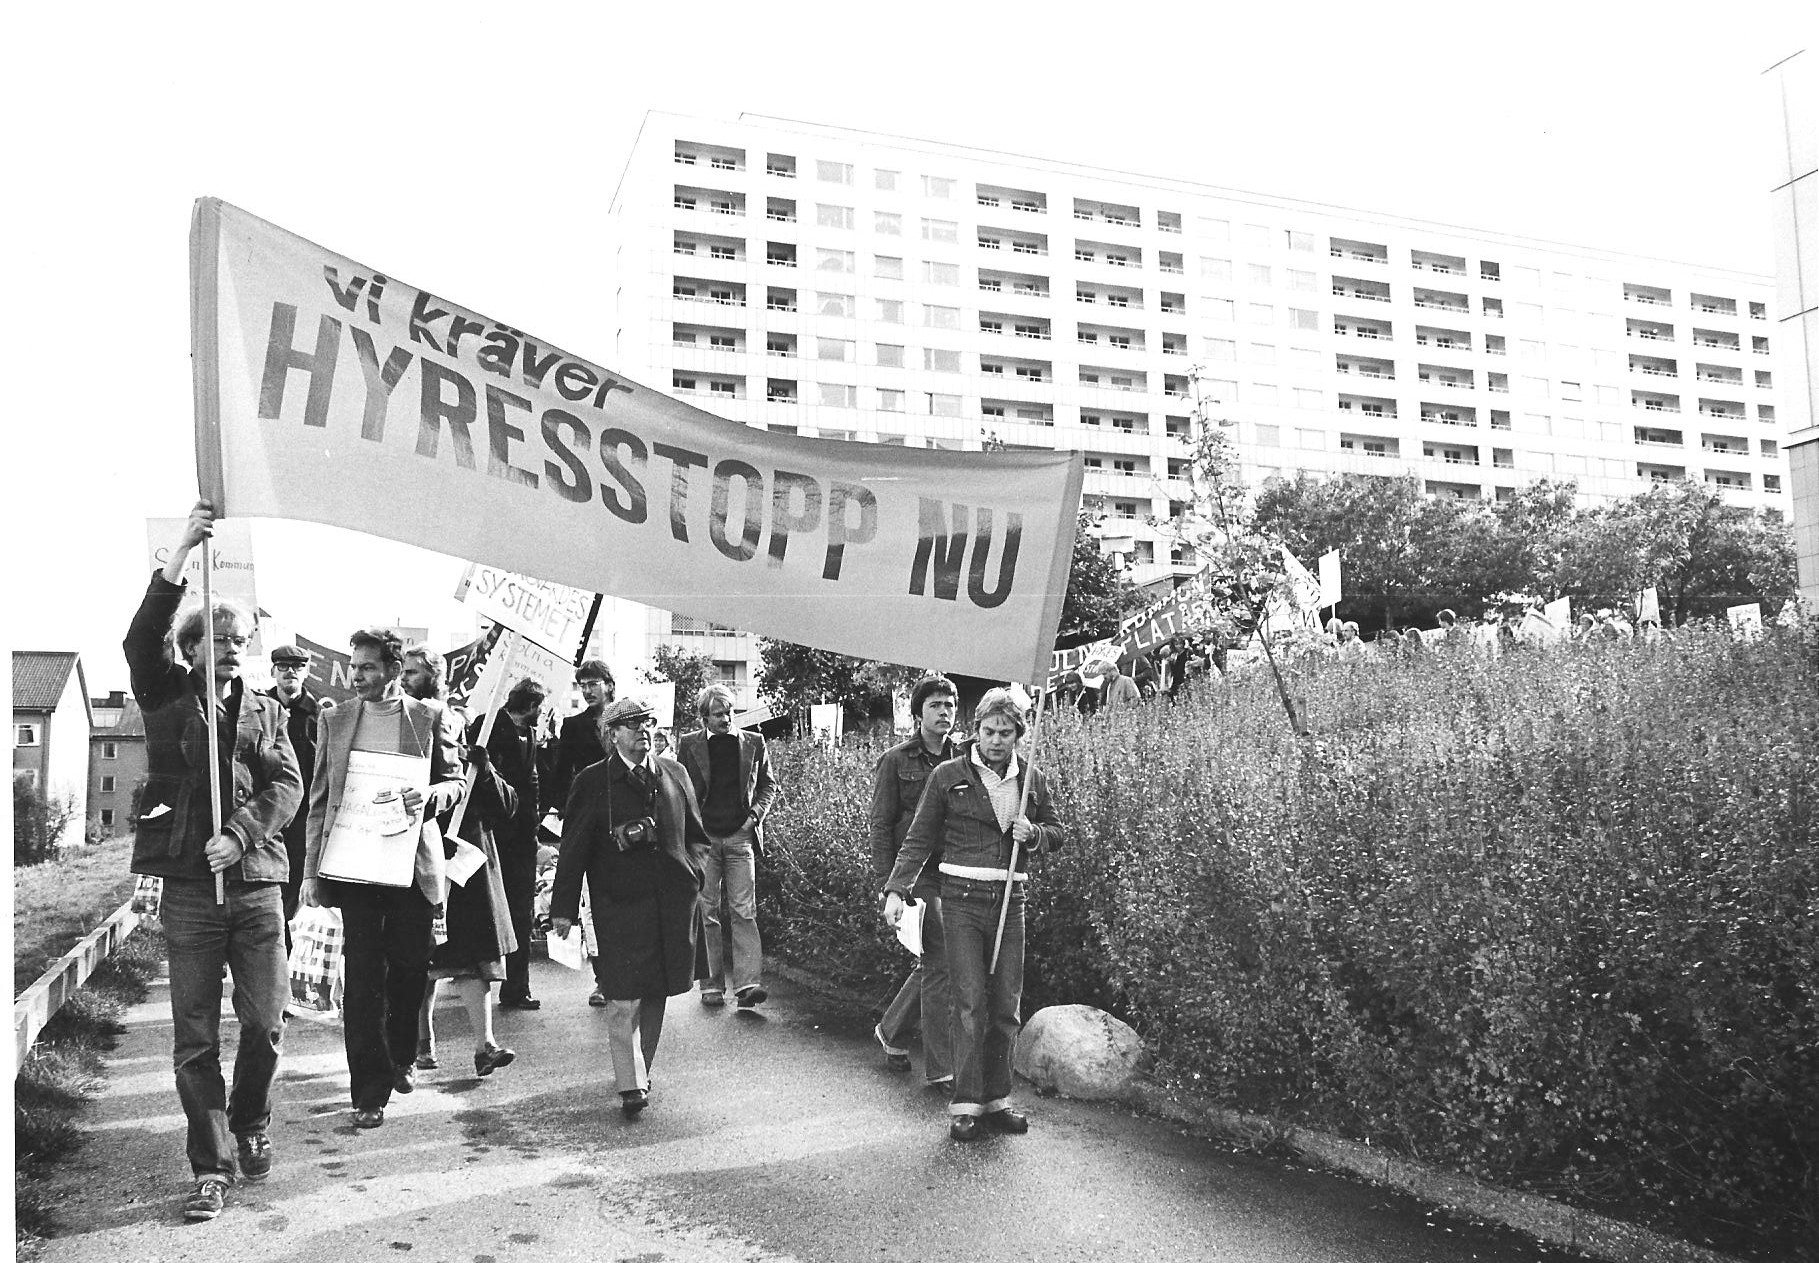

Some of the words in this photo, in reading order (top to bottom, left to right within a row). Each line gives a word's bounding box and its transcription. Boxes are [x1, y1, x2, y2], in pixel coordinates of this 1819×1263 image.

[323, 264, 388, 325] vi
[409, 290, 634, 409] kräver
[258, 301, 878, 581] HYRESSTOPP
[909, 496, 1023, 609] NU
[476, 569, 575, 644] SYSTEMET
